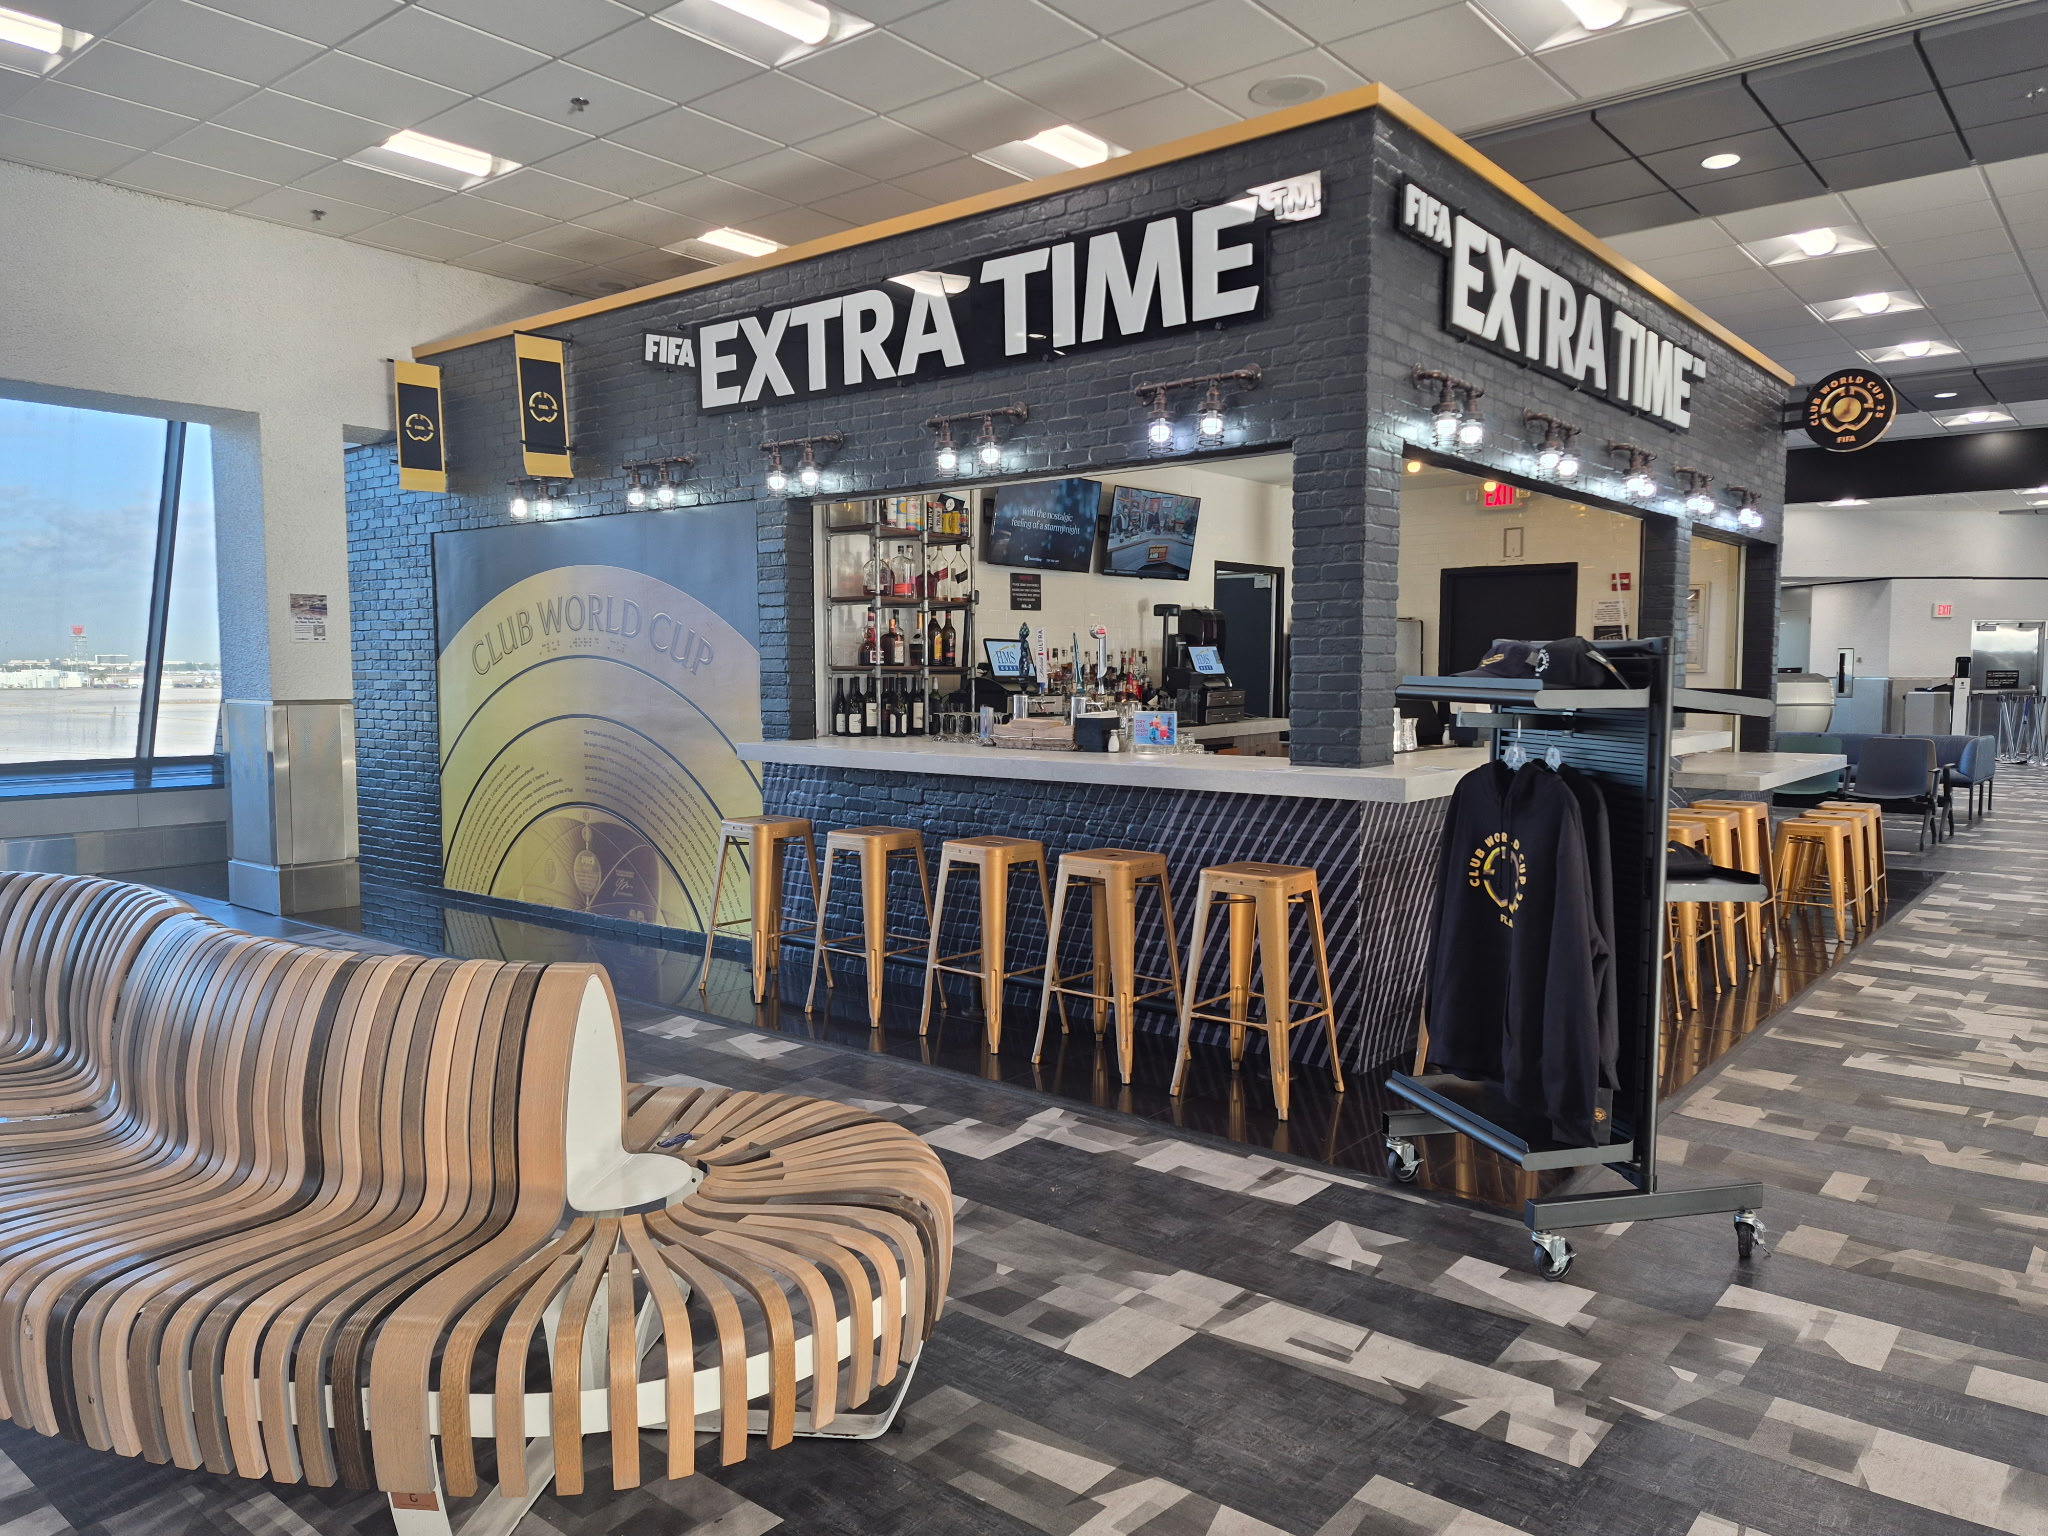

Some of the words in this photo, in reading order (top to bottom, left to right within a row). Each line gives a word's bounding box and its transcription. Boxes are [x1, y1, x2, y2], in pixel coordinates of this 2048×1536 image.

[645, 333, 695, 368] FIFA
[700, 272, 965, 408] EXTRA
[979, 195, 1261, 357] TIME
[1405, 184, 1452, 248] FIFA
[1452, 215, 1607, 390] EXTRA
[1613, 311, 1693, 428] TIME
[1819, 376, 1864, 395] WORLD
[1866, 381, 1885, 400] CUP
[1809, 397, 1822, 427] CLUB
[1874, 404, 1886, 418] 25
[1836, 435, 1857, 443] FIFA
[1022, 507, 1036, 517] with
[1037, 509, 1046, 518] the
[1047, 512, 1073, 523] nostalgic
[1012, 516, 1032, 530] feeling
[1032, 520, 1040, 530] of
[1066, 524, 1080, 536] night
[1938, 604, 1952, 615] EXIT
[472, 609, 533, 676] CLUB
[536, 594, 642, 639] WORLD
[649, 612, 715, 677] CUP
[1468, 848, 1486, 887] CLUB
[1484, 832, 1520, 850] WORD
[1518, 853, 1526, 885] CUP
